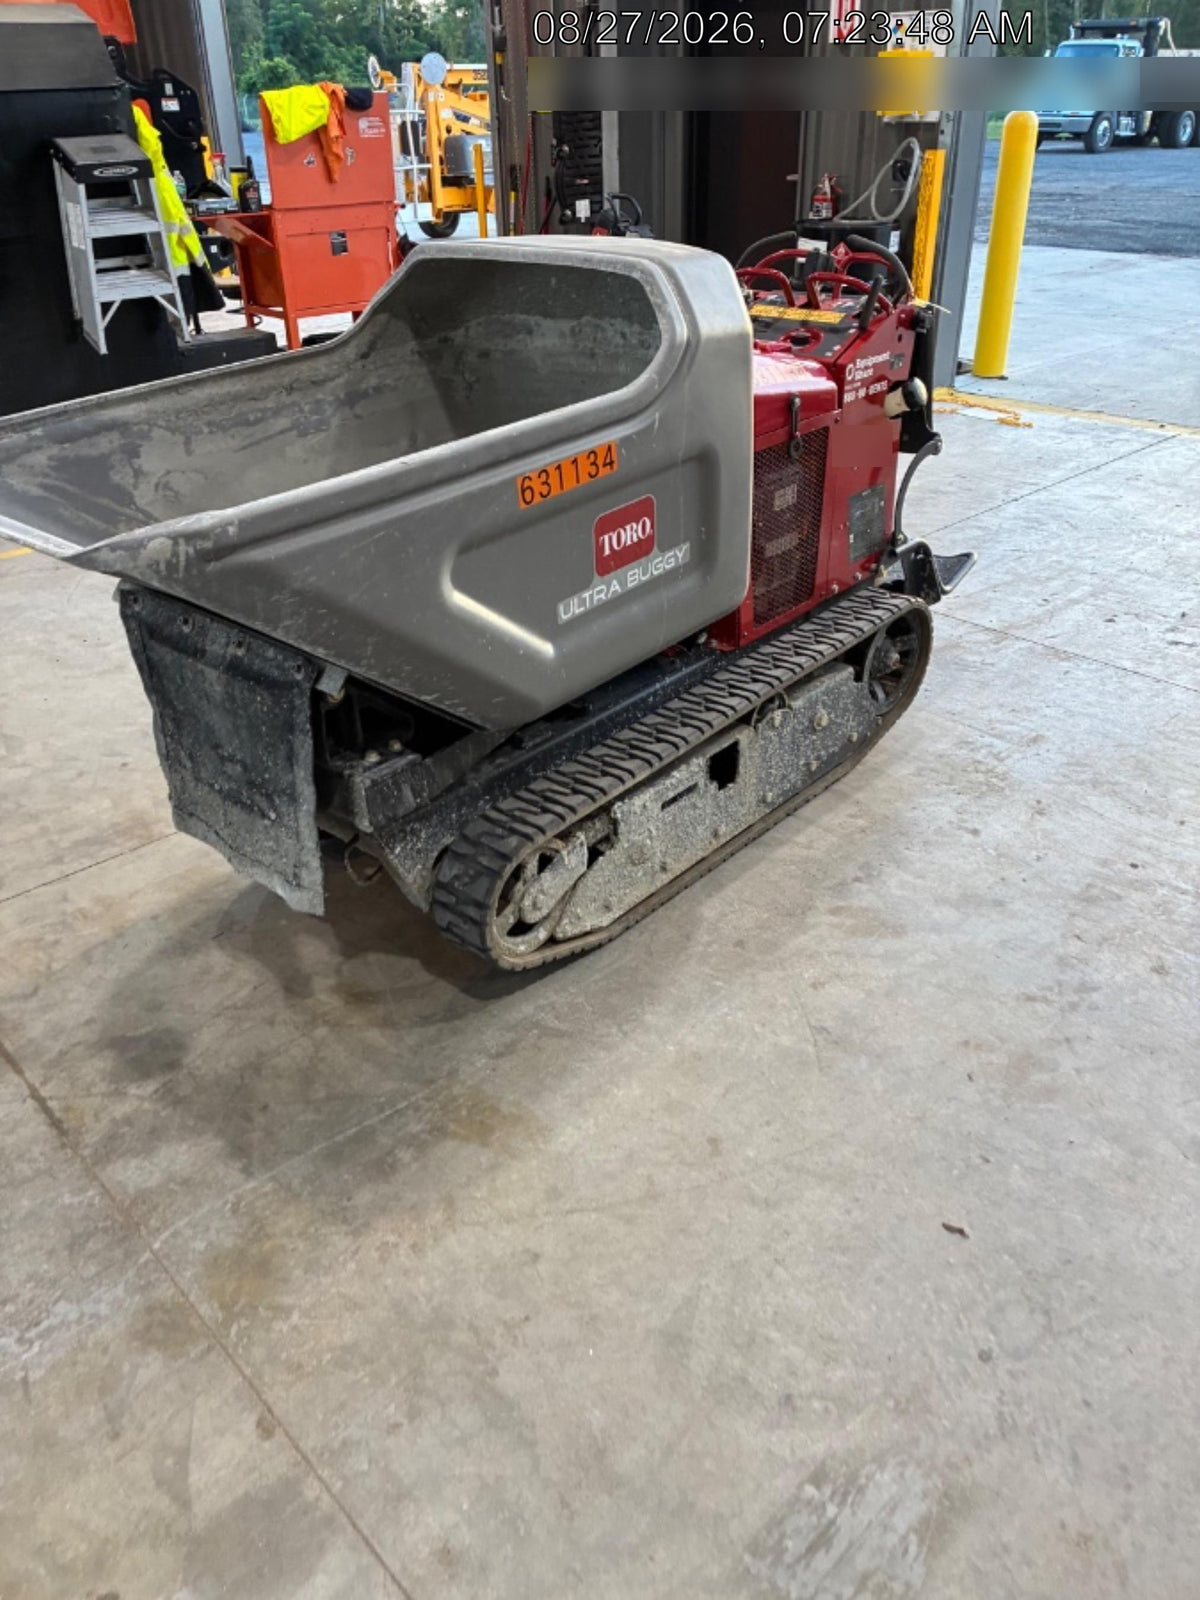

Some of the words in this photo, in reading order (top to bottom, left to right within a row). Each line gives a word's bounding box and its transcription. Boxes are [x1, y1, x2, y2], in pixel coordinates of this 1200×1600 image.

[855, 350, 891, 369] Equipment
[519, 443, 616, 506] 631134
[599, 516, 653, 557] TORO
[558, 578, 622, 620] ULTRA
[626, 543, 690, 588] BUGGY
